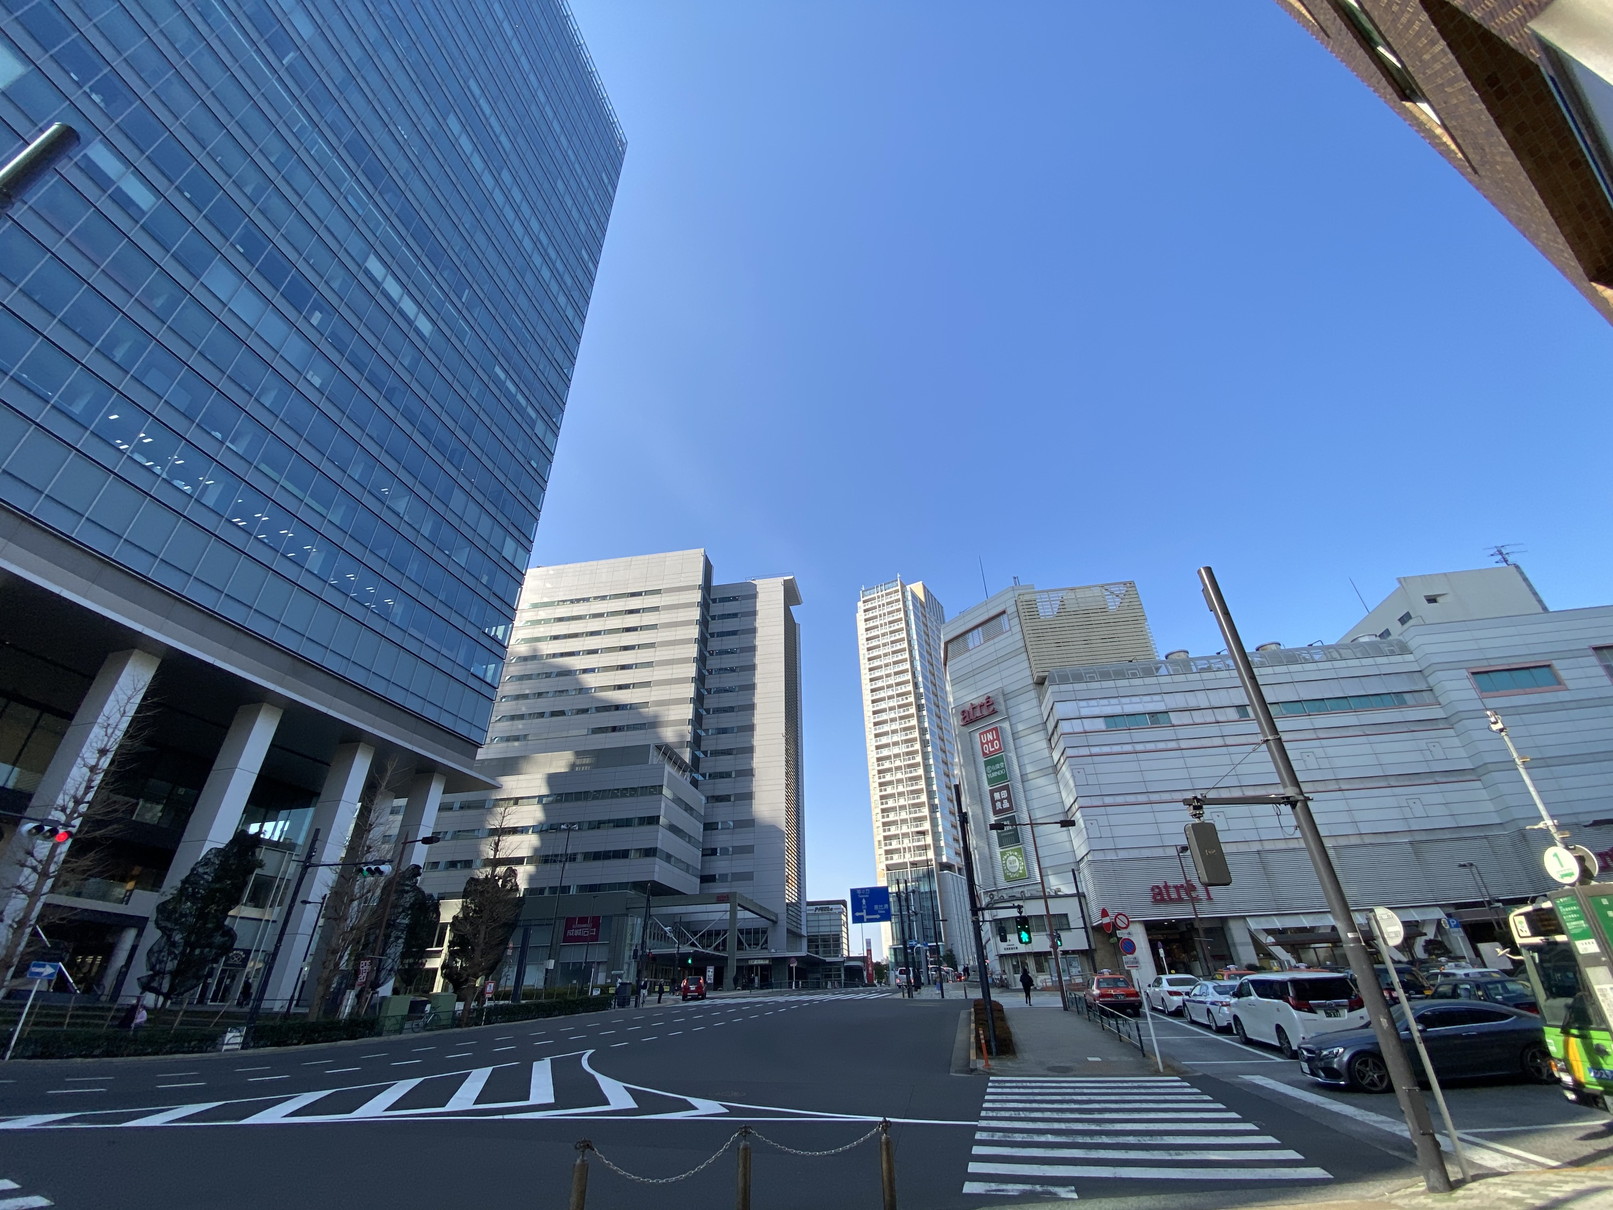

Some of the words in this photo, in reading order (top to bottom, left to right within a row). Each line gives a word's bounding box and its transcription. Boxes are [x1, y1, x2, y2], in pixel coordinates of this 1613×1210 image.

[960, 696, 998, 725] atré
[980, 730, 997, 743] UNI
[983, 741, 1000, 754] QLO
[993, 790, 1008, 801] 無印
[995, 798, 1010, 810] 良品
[1552, 851, 1565, 868] 1
[1151, 880, 1199, 903] atré
[1449, 919, 1457, 928] P
